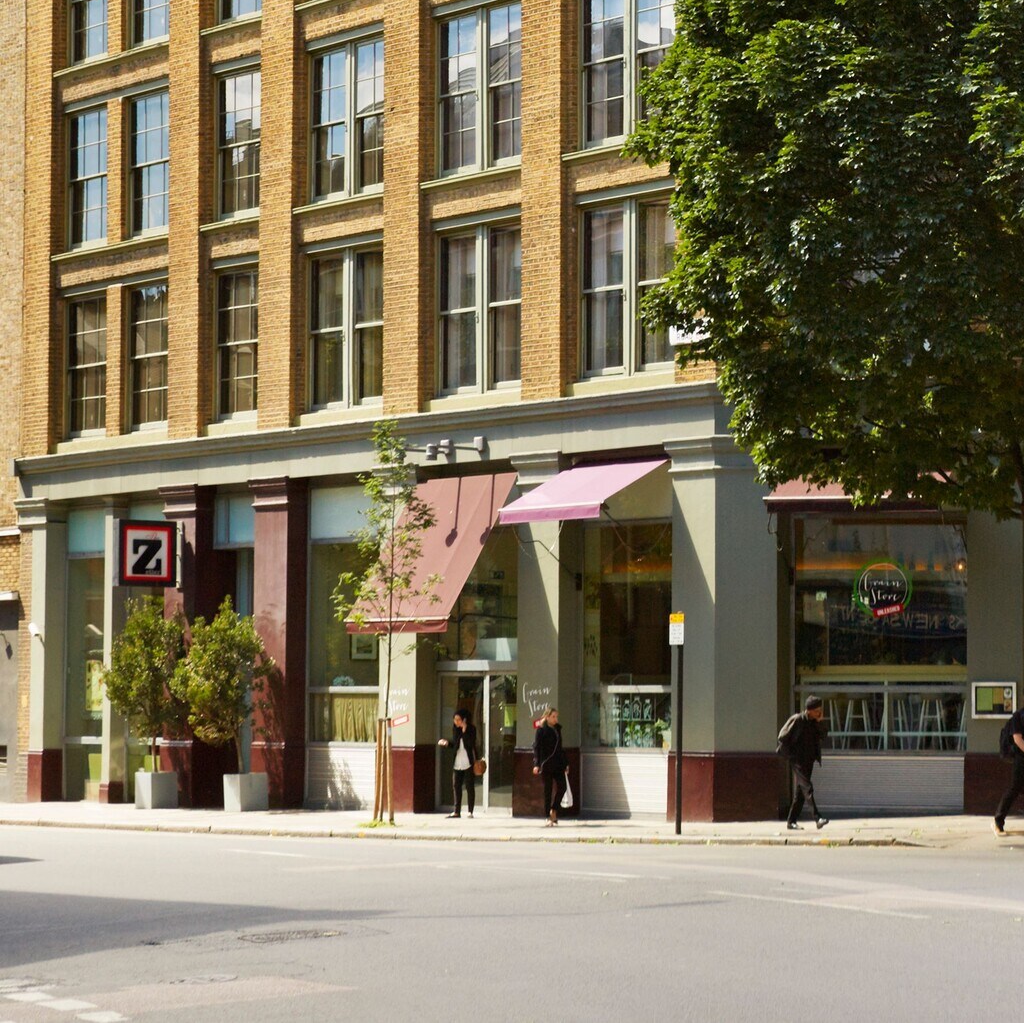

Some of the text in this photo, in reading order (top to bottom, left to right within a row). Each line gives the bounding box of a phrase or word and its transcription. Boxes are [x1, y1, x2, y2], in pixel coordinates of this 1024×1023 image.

[863, 572, 904, 591] Grain
[871, 588, 902, 605] Store
[522, 681, 552, 703] Grain
